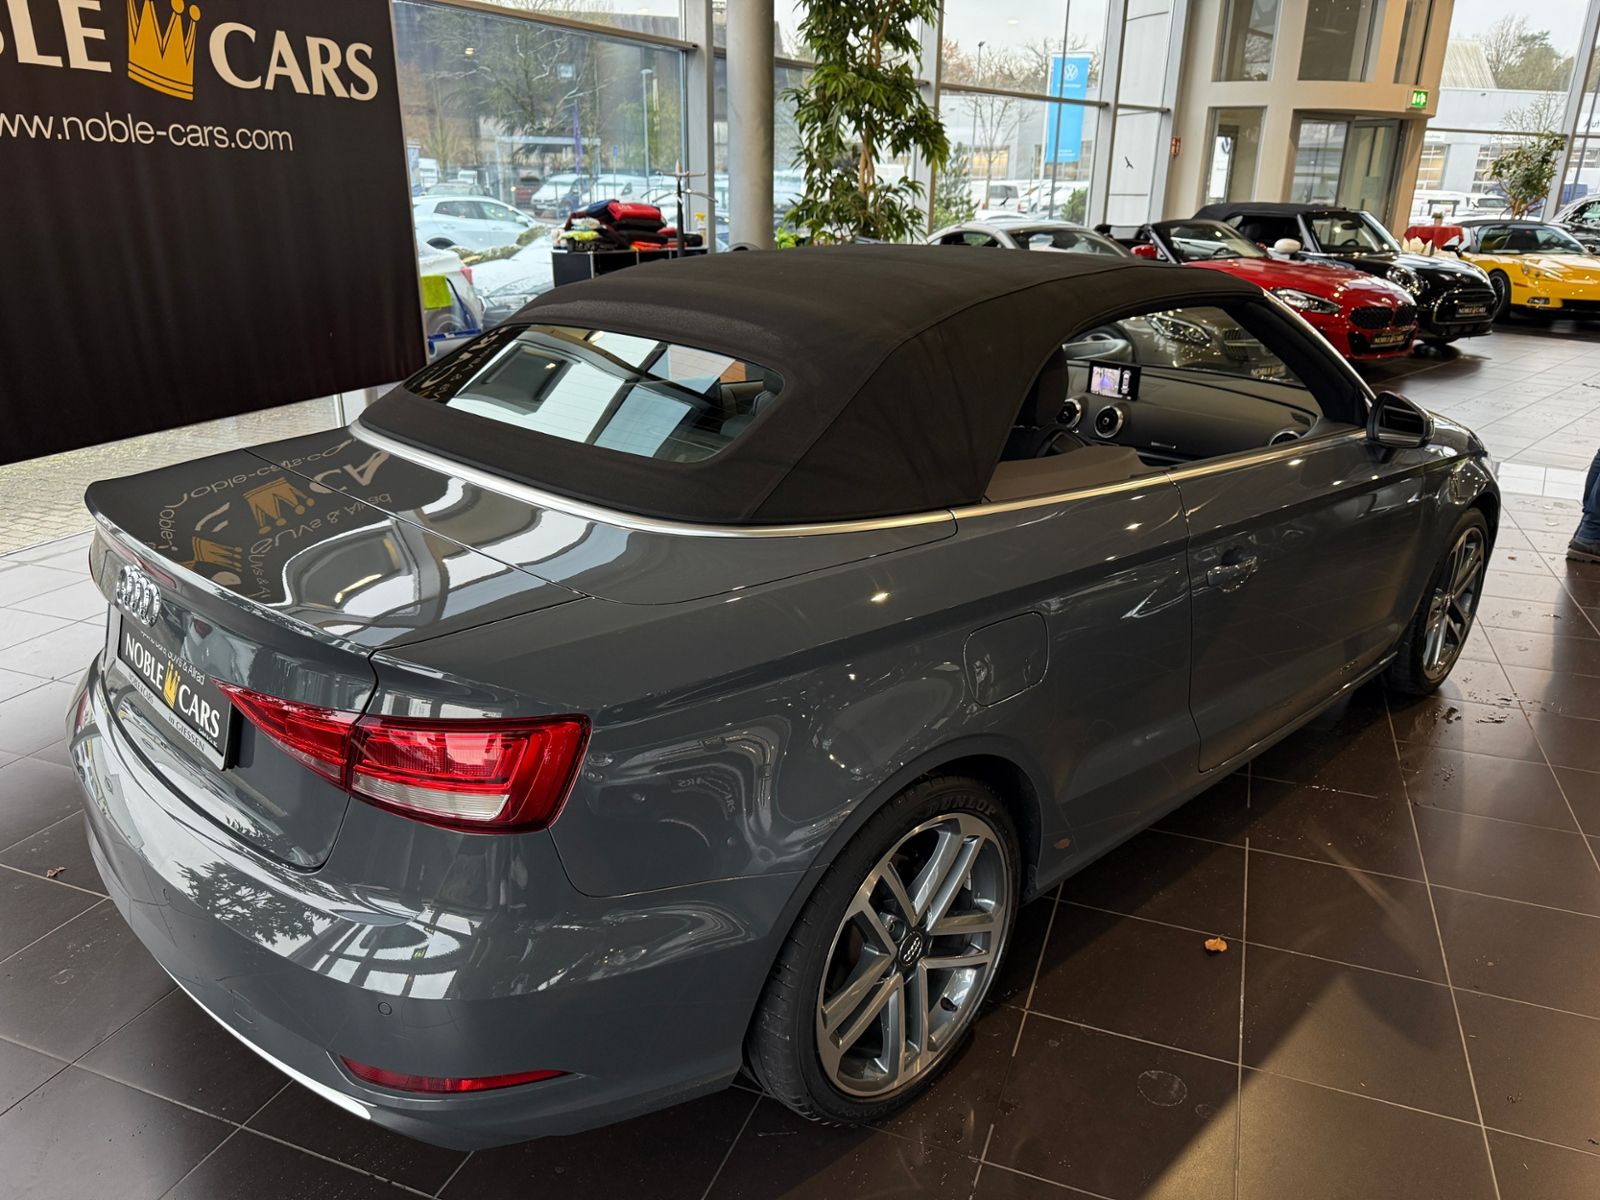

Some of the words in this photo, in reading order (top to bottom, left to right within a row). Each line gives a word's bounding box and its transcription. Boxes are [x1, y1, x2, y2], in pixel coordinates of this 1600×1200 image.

[0, 0, 112, 72] LE
[208, 21, 379, 101] CARS
[125, 632, 165, 692] NOBLE
[178, 684, 220, 738] CARS
[175, 718, 206, 752] GIESSEN
[928, 794, 997, 816] DUNLOP
